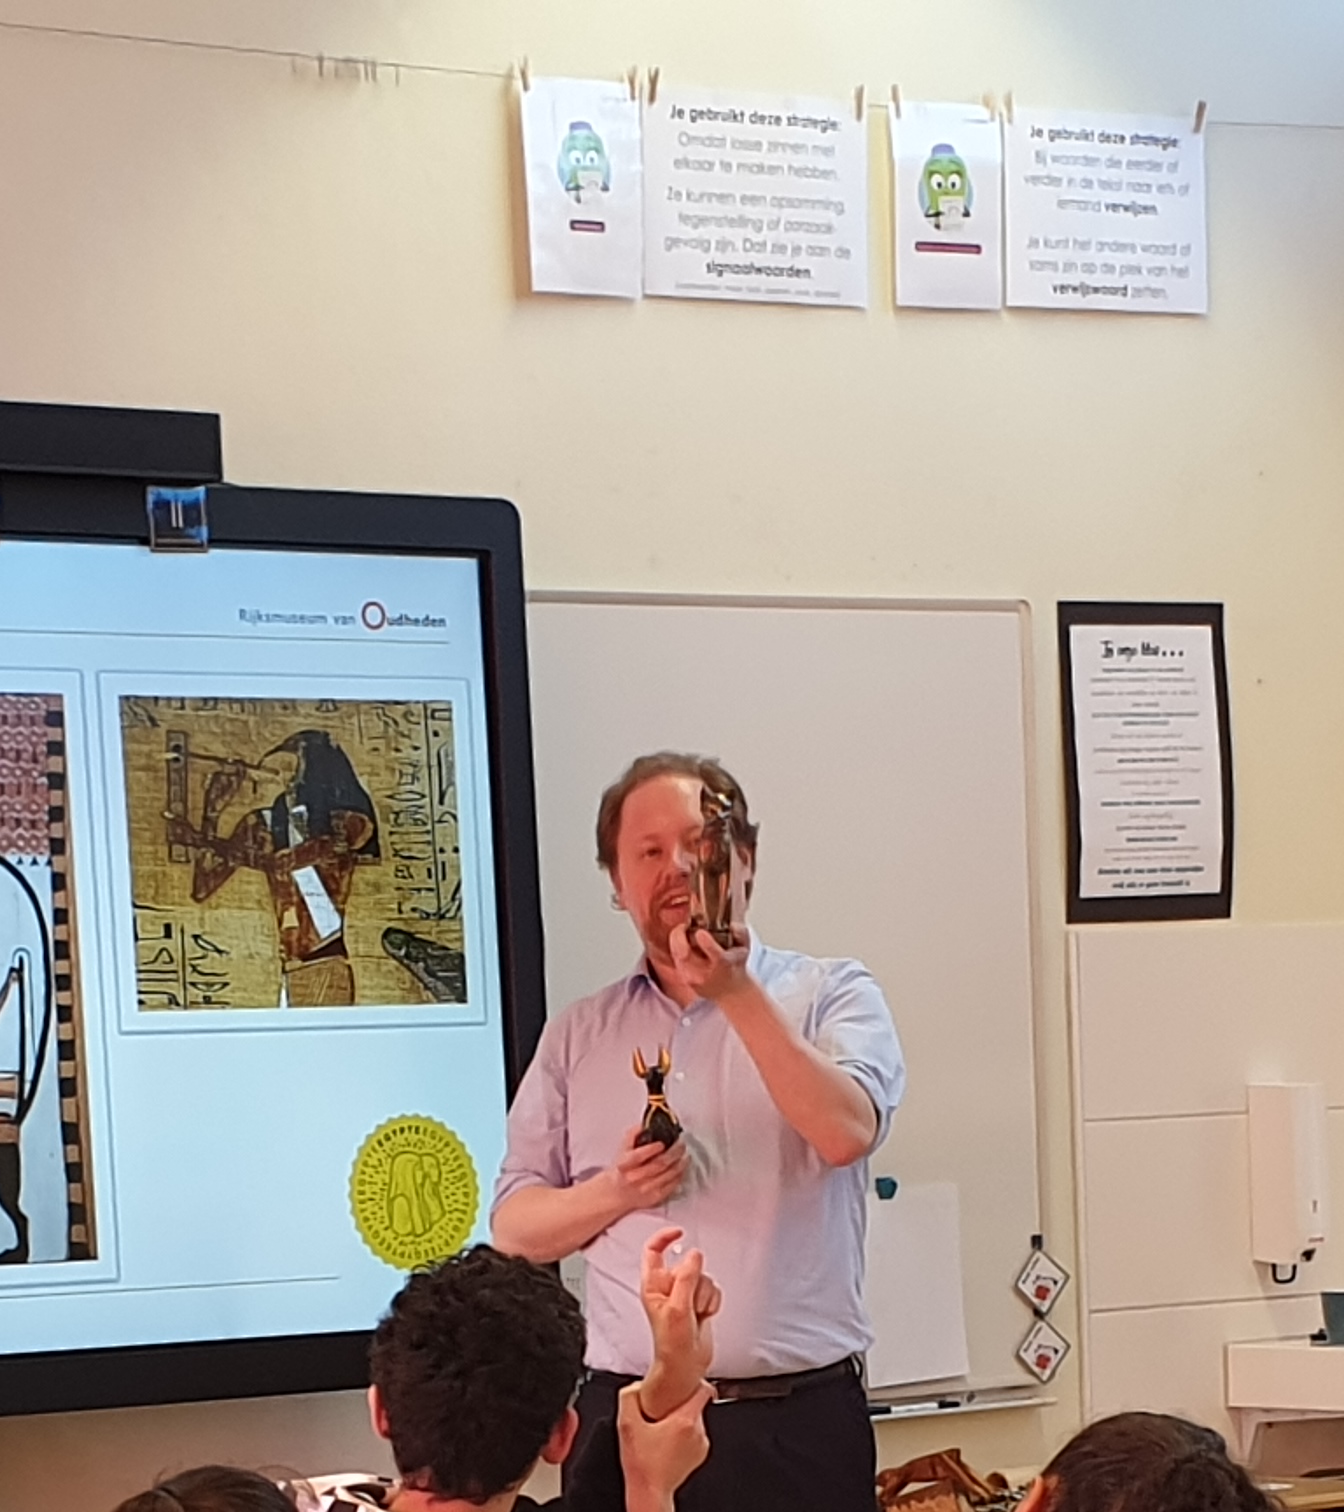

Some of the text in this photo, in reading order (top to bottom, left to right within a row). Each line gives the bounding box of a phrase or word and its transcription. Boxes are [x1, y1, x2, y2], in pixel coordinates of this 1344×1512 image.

[670, 105, 685, 120] Je
[689, 107, 745, 127] gebruikt
[749, 111, 782, 126] deze
[678, 132, 726, 147] Omdat
[767, 139, 808, 154] zinnen
[1030, 125, 1043, 139] Je
[1048, 127, 1094, 143] gebruikt
[1098, 130, 1126, 144] deze
[673, 157, 714, 171] elkaar
[719, 159, 732, 173] te
[736, 162, 784, 175] maken
[686, 190, 736, 204] kunnen
[740, 194, 767, 206] een
[678, 211, 763, 233] tegenstelling
[767, 218, 780, 231] of
[742, 238, 767, 253] Dat
[791, 241, 802, 258] je
[835, 244, 850, 260] de
[1027, 237, 1040, 249] Je
[1043, 237, 1069, 250] kunt
[1073, 237, 1092, 251] het
[238, 600, 447, 630] Rijksmuseum van Oudheden
